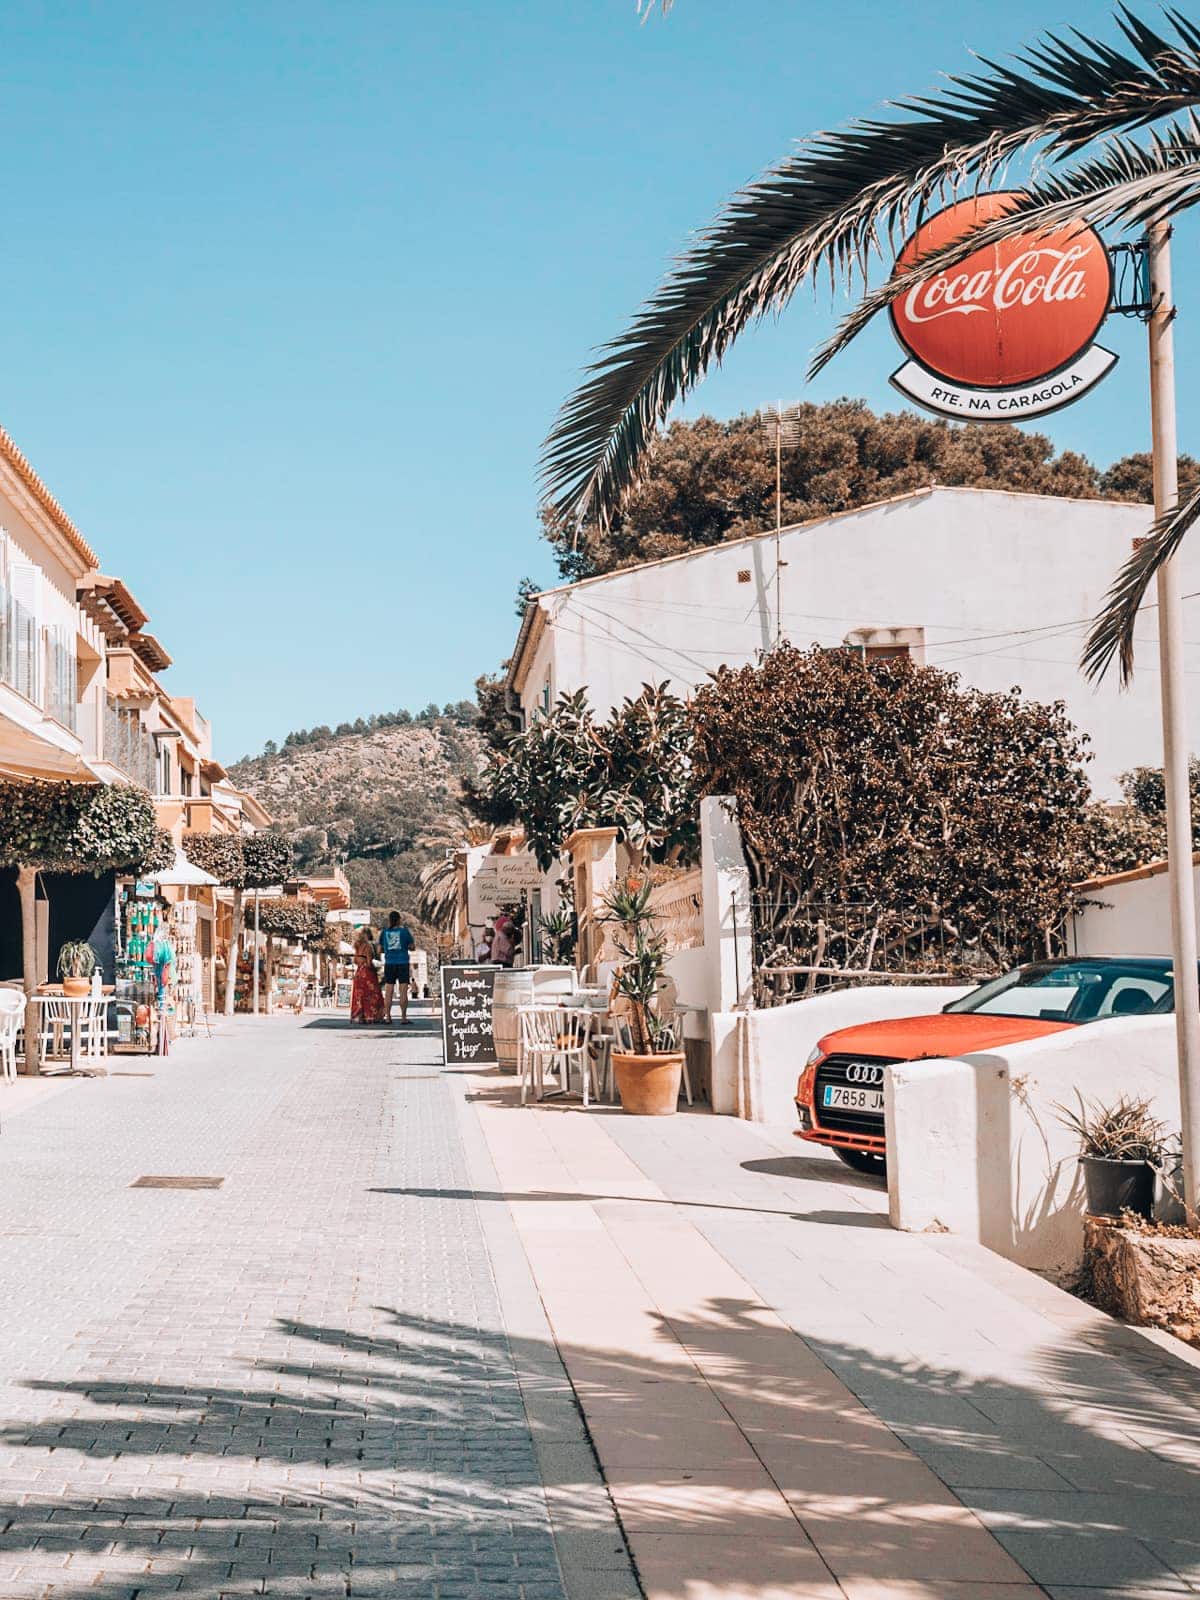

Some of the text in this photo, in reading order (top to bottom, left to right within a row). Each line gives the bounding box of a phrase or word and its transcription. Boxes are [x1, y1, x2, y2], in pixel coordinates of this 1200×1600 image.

[930, 374, 1083, 410] RTE. NA CARAGOLA
[833, 1089, 866, 1107] 7858
